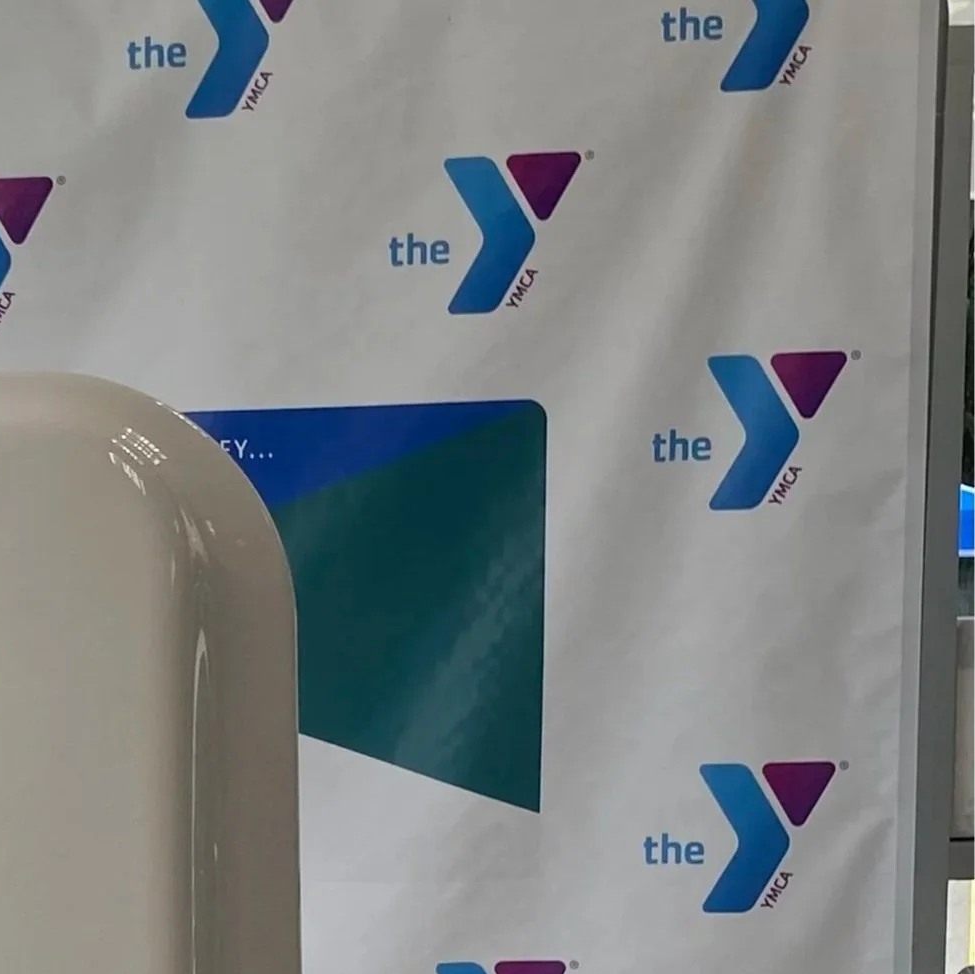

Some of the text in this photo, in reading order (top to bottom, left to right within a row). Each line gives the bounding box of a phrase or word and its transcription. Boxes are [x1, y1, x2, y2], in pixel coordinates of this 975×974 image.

[661, 7, 723, 42] the
[128, 36, 186, 69] the
[779, 46, 812, 85] YMCA
[242, 72, 273, 111] YMCA
[389, 233, 449, 266] the
[506, 269, 538, 307] YMCA
[652, 429, 711, 462] the
[768, 467, 802, 504] YMCA
[644, 833, 704, 864] the
[760, 872, 793, 908] YMCA
